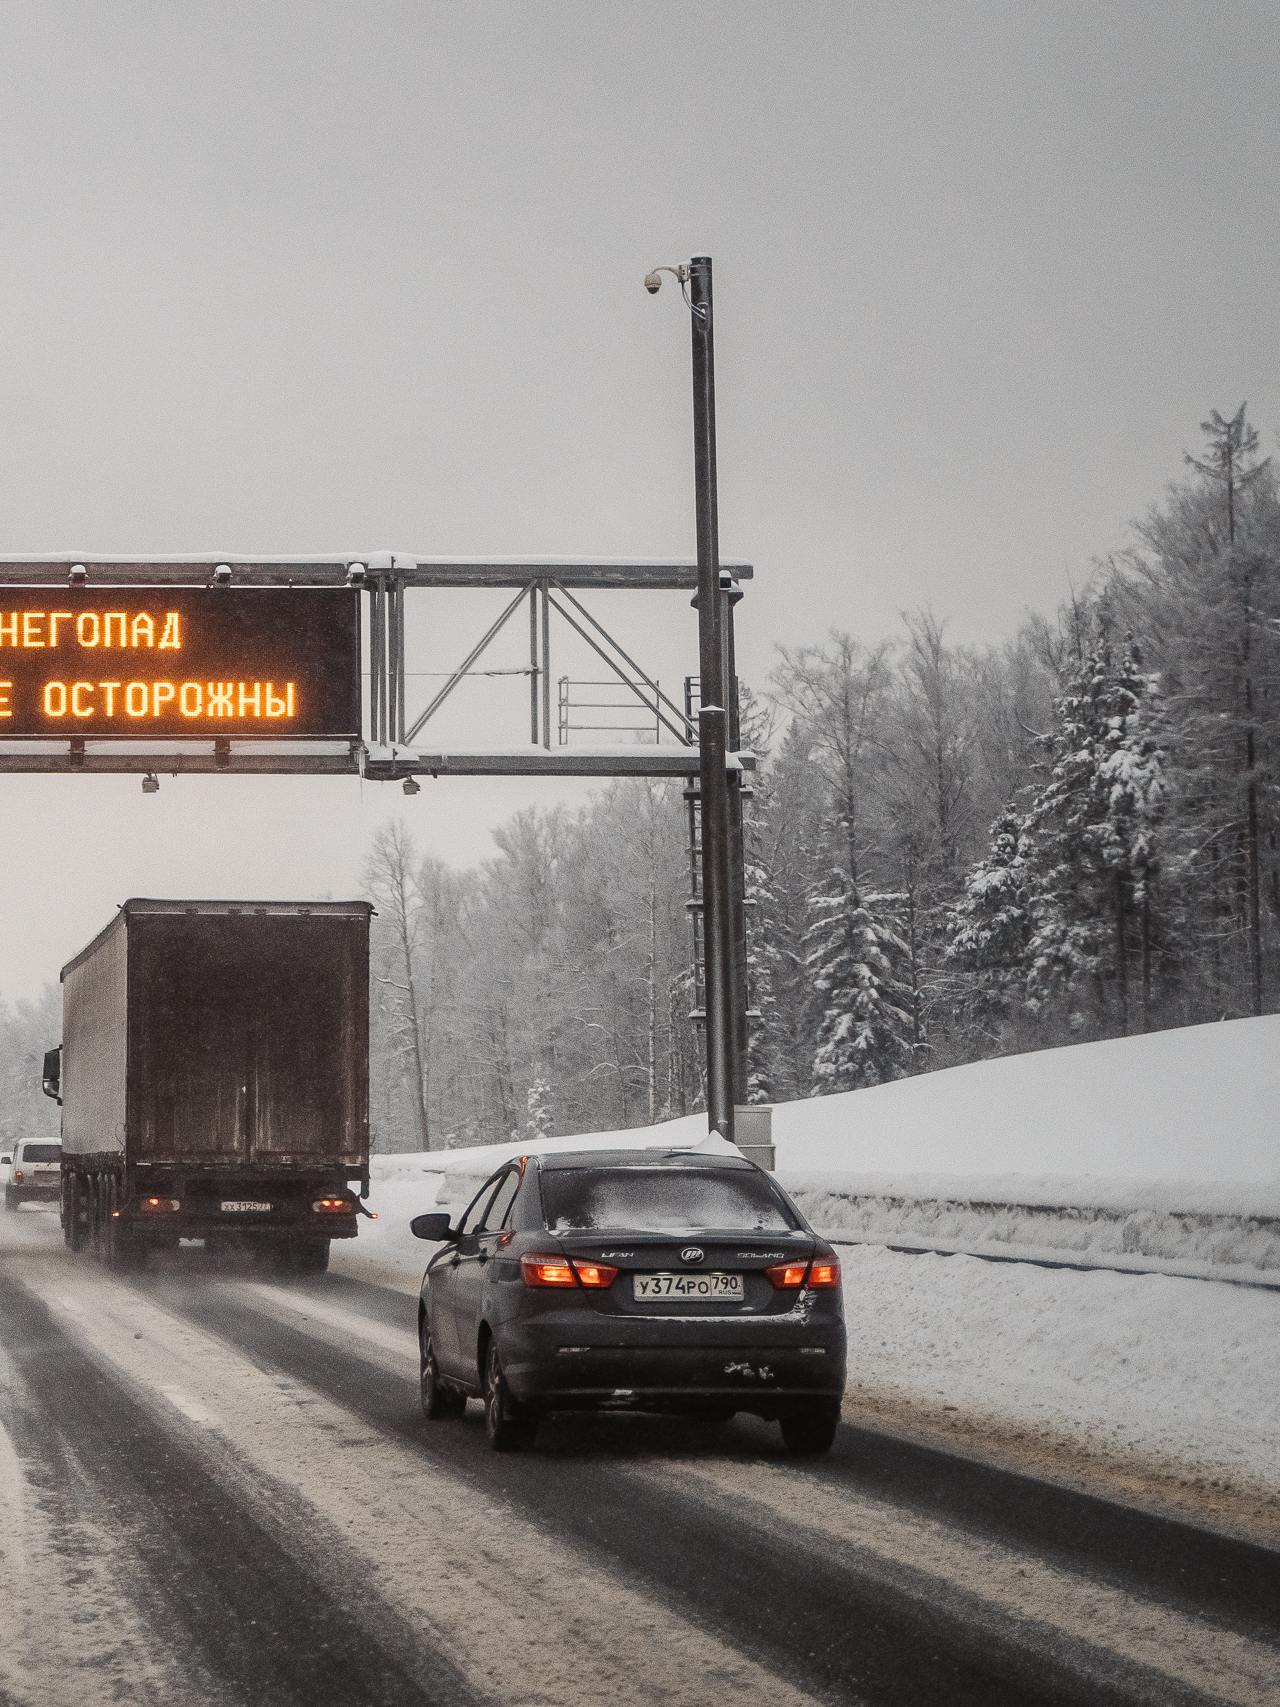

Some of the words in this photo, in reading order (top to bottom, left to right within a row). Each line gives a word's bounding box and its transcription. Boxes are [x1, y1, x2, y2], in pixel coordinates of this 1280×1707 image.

[43, 681, 295, 719] ОСТОРОЖНЫ
[640, 1277, 709, 1295] У374РО
[711, 1276, 738, 1290] 790
